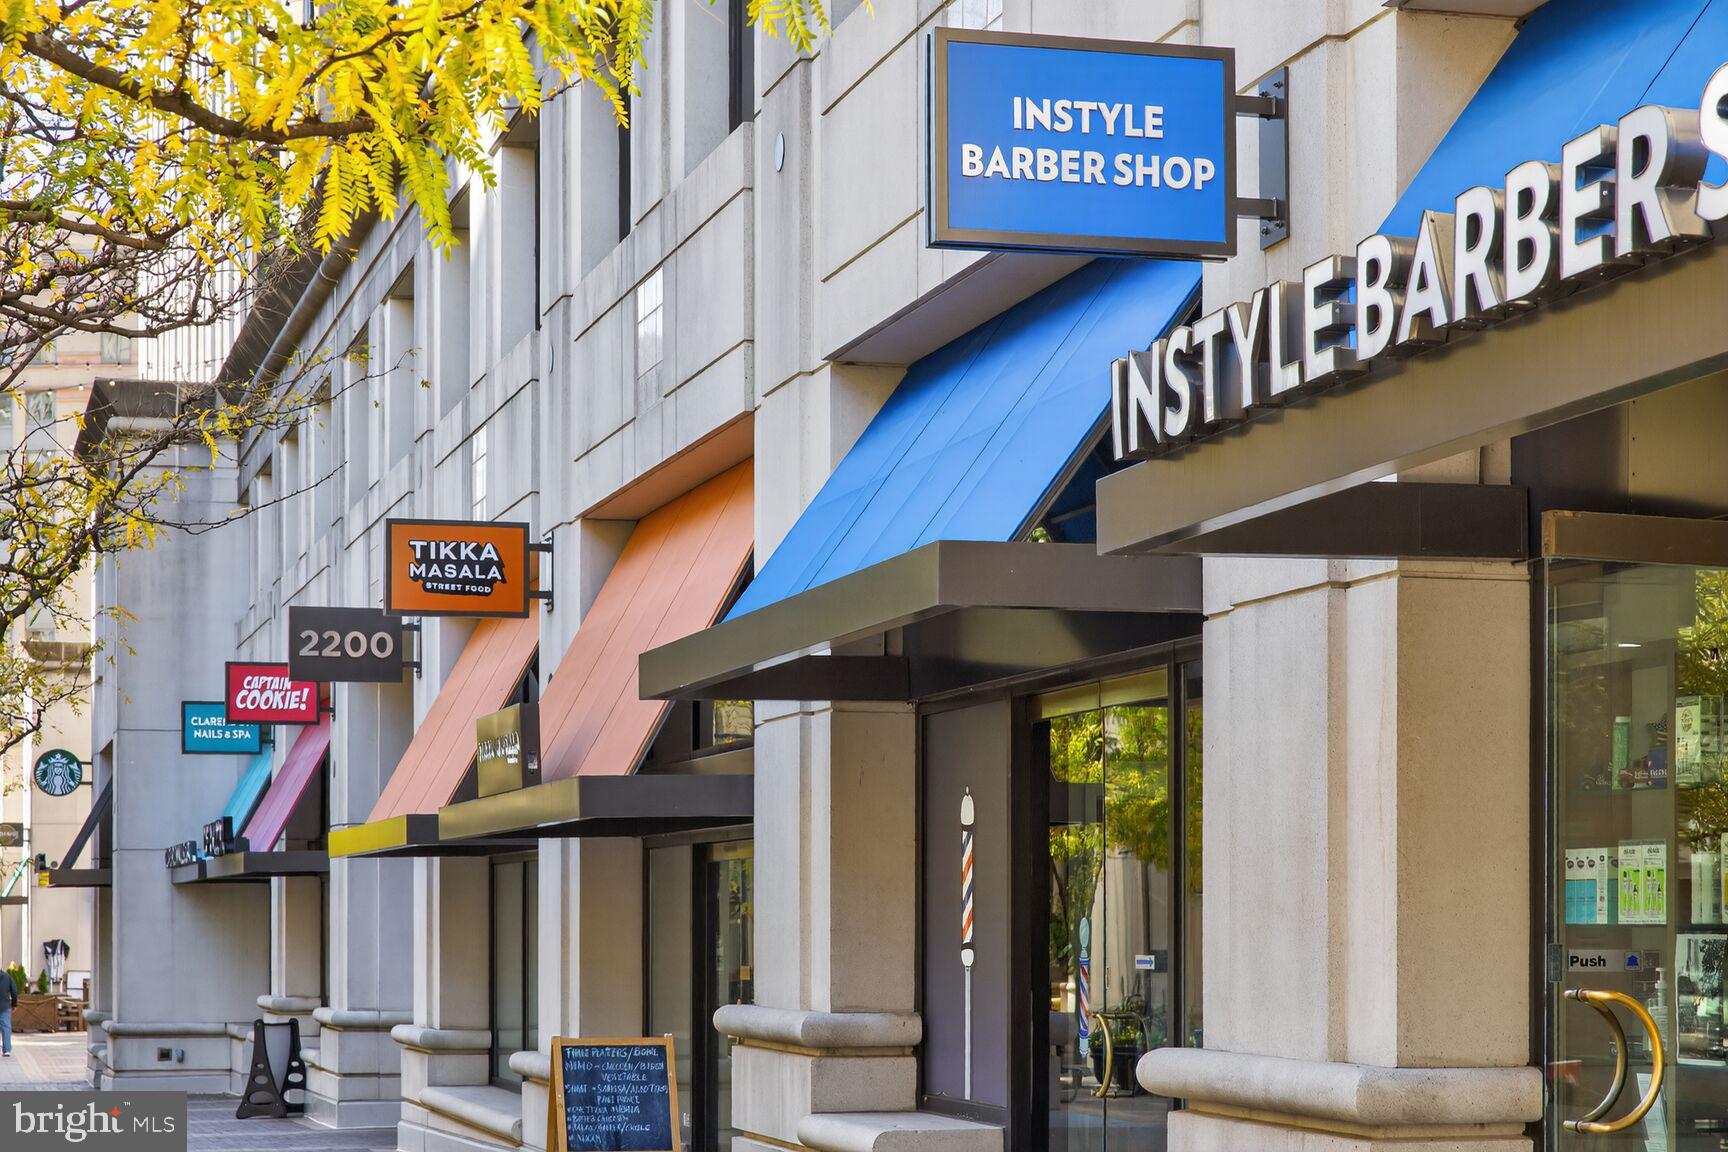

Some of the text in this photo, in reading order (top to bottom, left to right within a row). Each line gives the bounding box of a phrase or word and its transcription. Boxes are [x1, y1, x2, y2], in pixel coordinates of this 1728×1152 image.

[1013, 96, 1164, 138] INSTYLE
[961, 143, 1215, 190] BARBER SHOP
[1110, 254, 1356, 461] INSTYLE
[1356, 104, 1676, 362] BARBER
[409, 540, 499, 561] TIKKA
[409, 563, 502, 580] MASALA
[425, 582, 492, 593] STREET FOOD
[299, 629, 394, 658] 2200
[243, 675, 292, 690] CAPTAIN
[235, 688, 310, 711] COOKIE!
[193, 729, 223, 739] NAILS
[232, 730, 251, 739] SPA
[1569, 955, 1607, 967] Push
